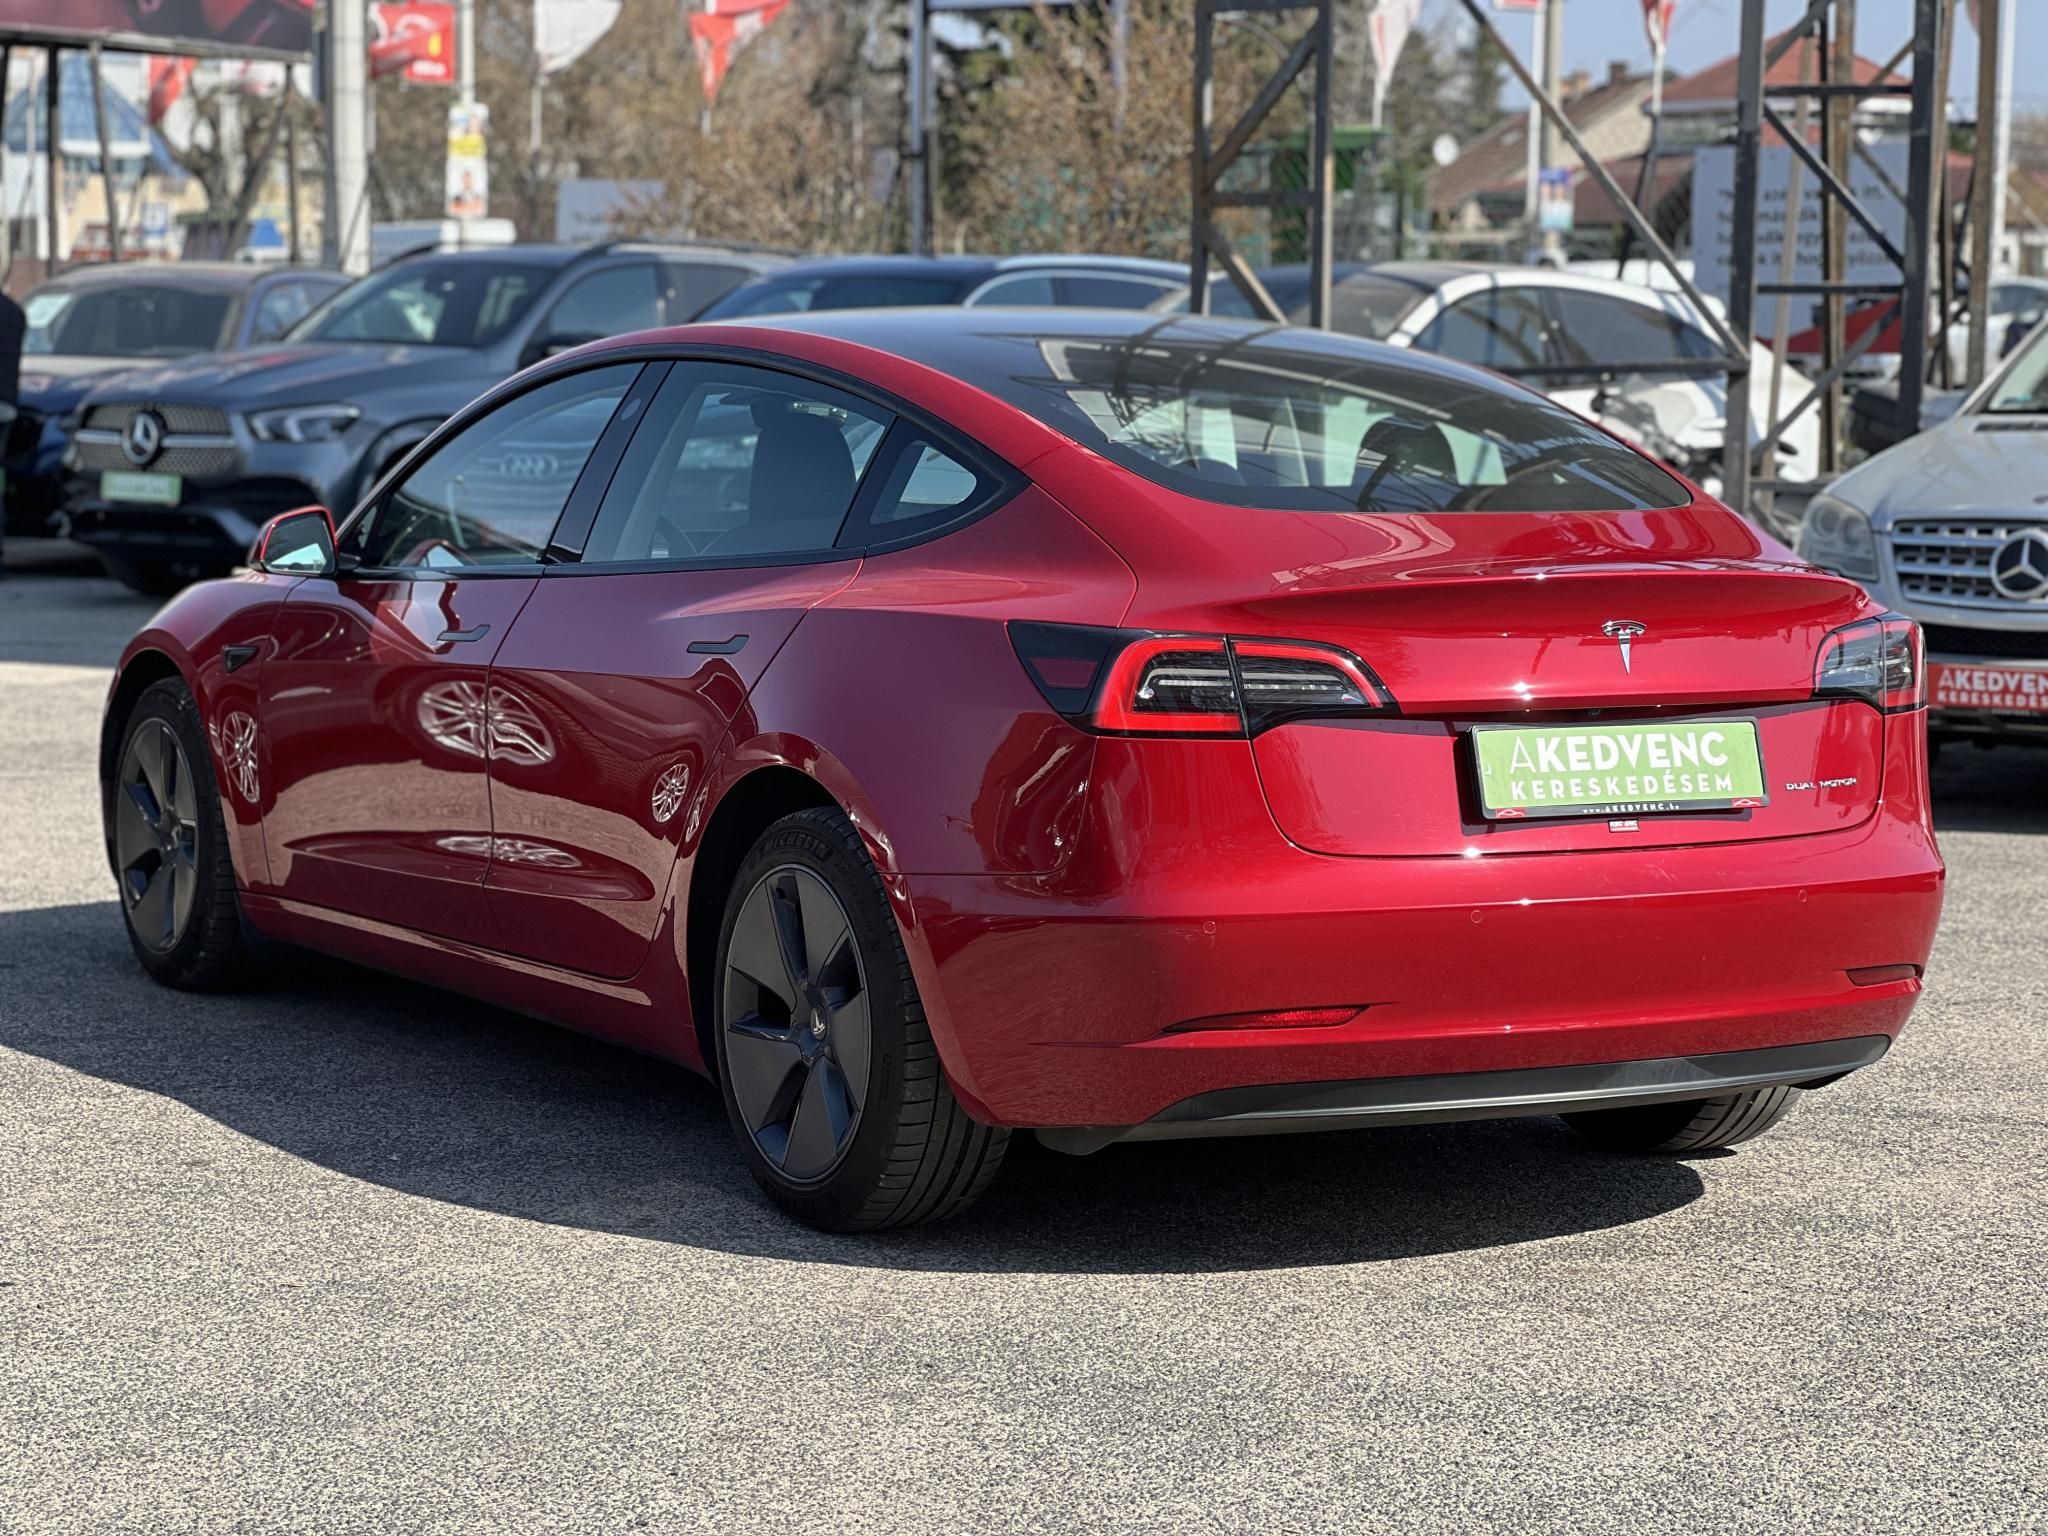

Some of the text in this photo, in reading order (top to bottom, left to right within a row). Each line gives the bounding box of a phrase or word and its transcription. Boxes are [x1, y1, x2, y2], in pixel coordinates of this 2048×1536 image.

[1510, 731, 1729, 773] AKEDVENC
[1511, 770, 1733, 800] KERESKEDÉSEM
[1785, 777, 1857, 791] DUAL MOTOR
[761, 831, 831, 860] MICHELIN
